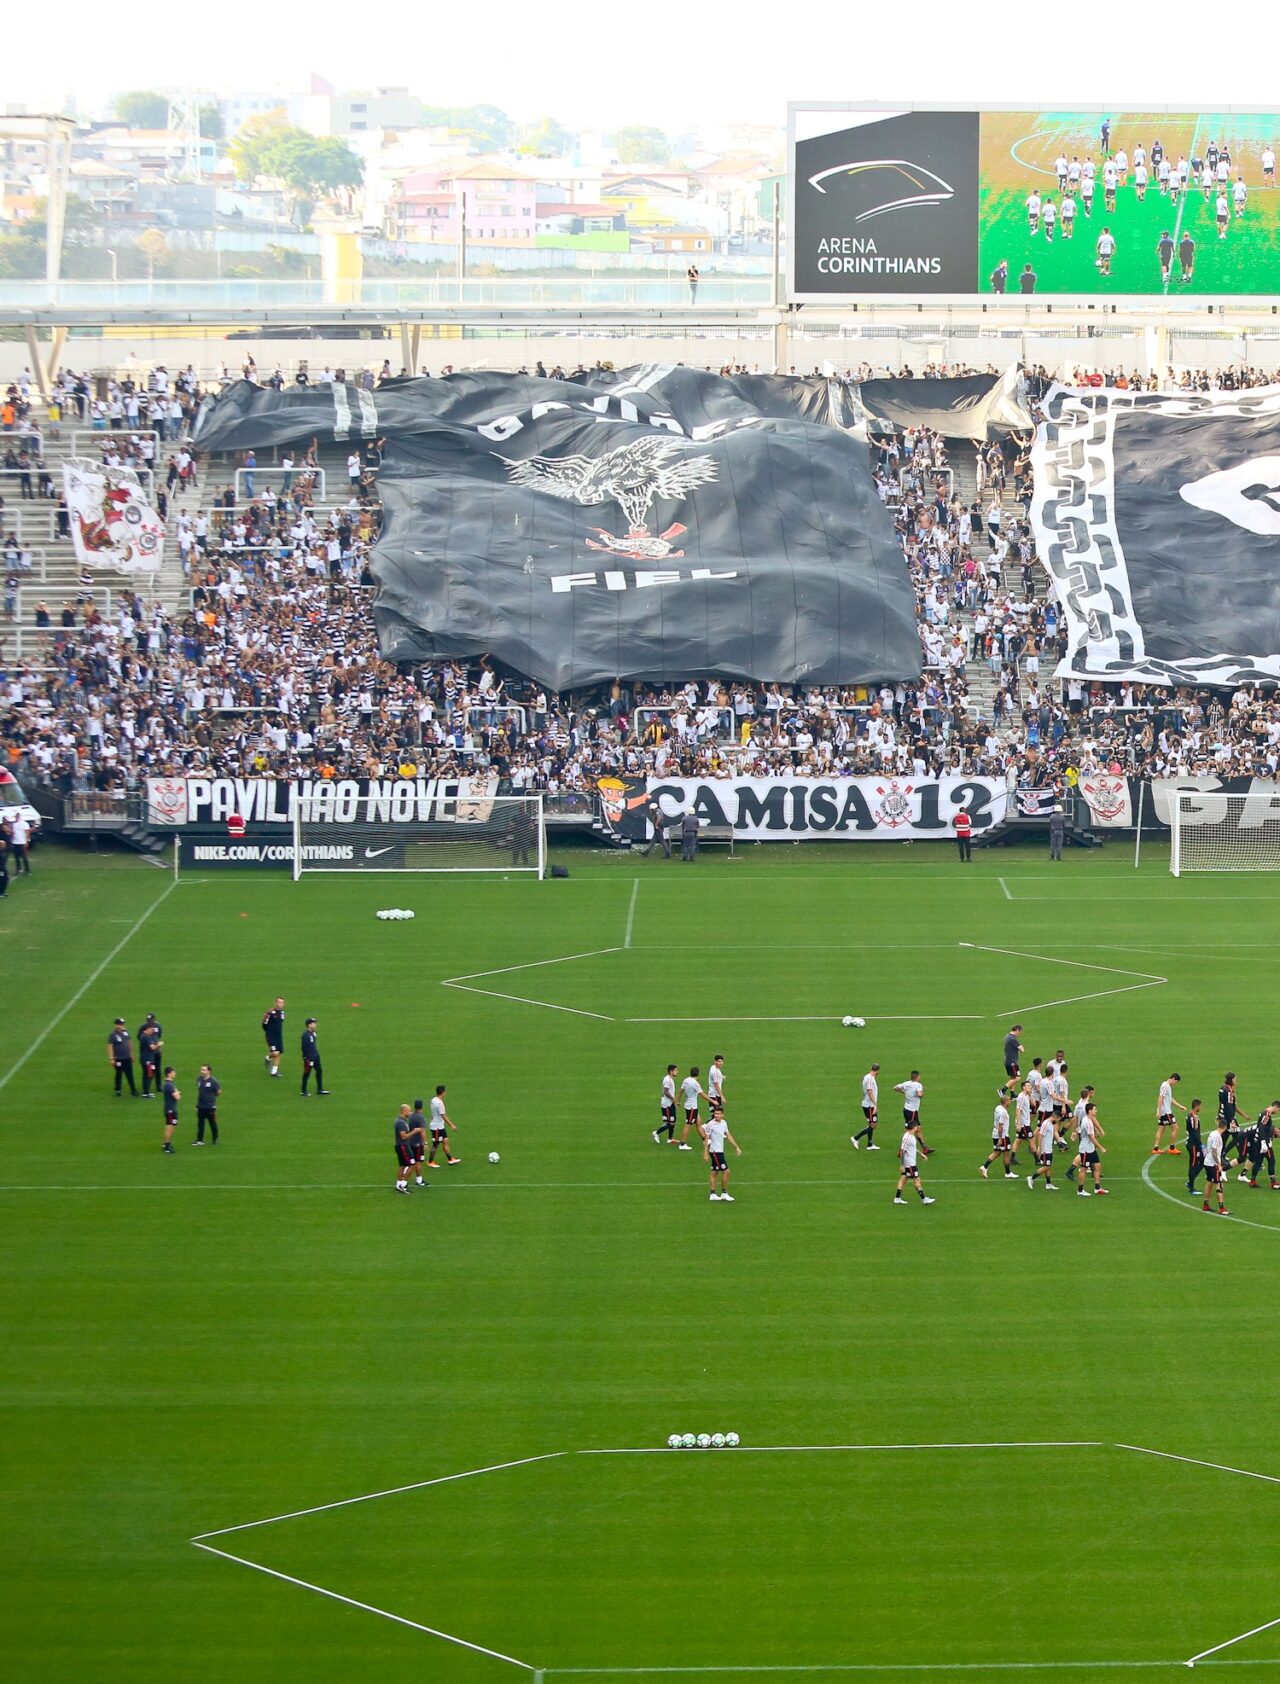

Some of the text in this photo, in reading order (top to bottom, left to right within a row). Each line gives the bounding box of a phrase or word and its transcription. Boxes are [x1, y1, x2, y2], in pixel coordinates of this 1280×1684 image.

[817, 238, 878, 254] ARENA
[817, 257, 942, 274] CORINTHIANS
[550, 567, 738, 594] FIEL
[366, 778, 460, 823] NOVE
[648, 784, 878, 831] CAMISA
[911, 782, 994, 829] 12
